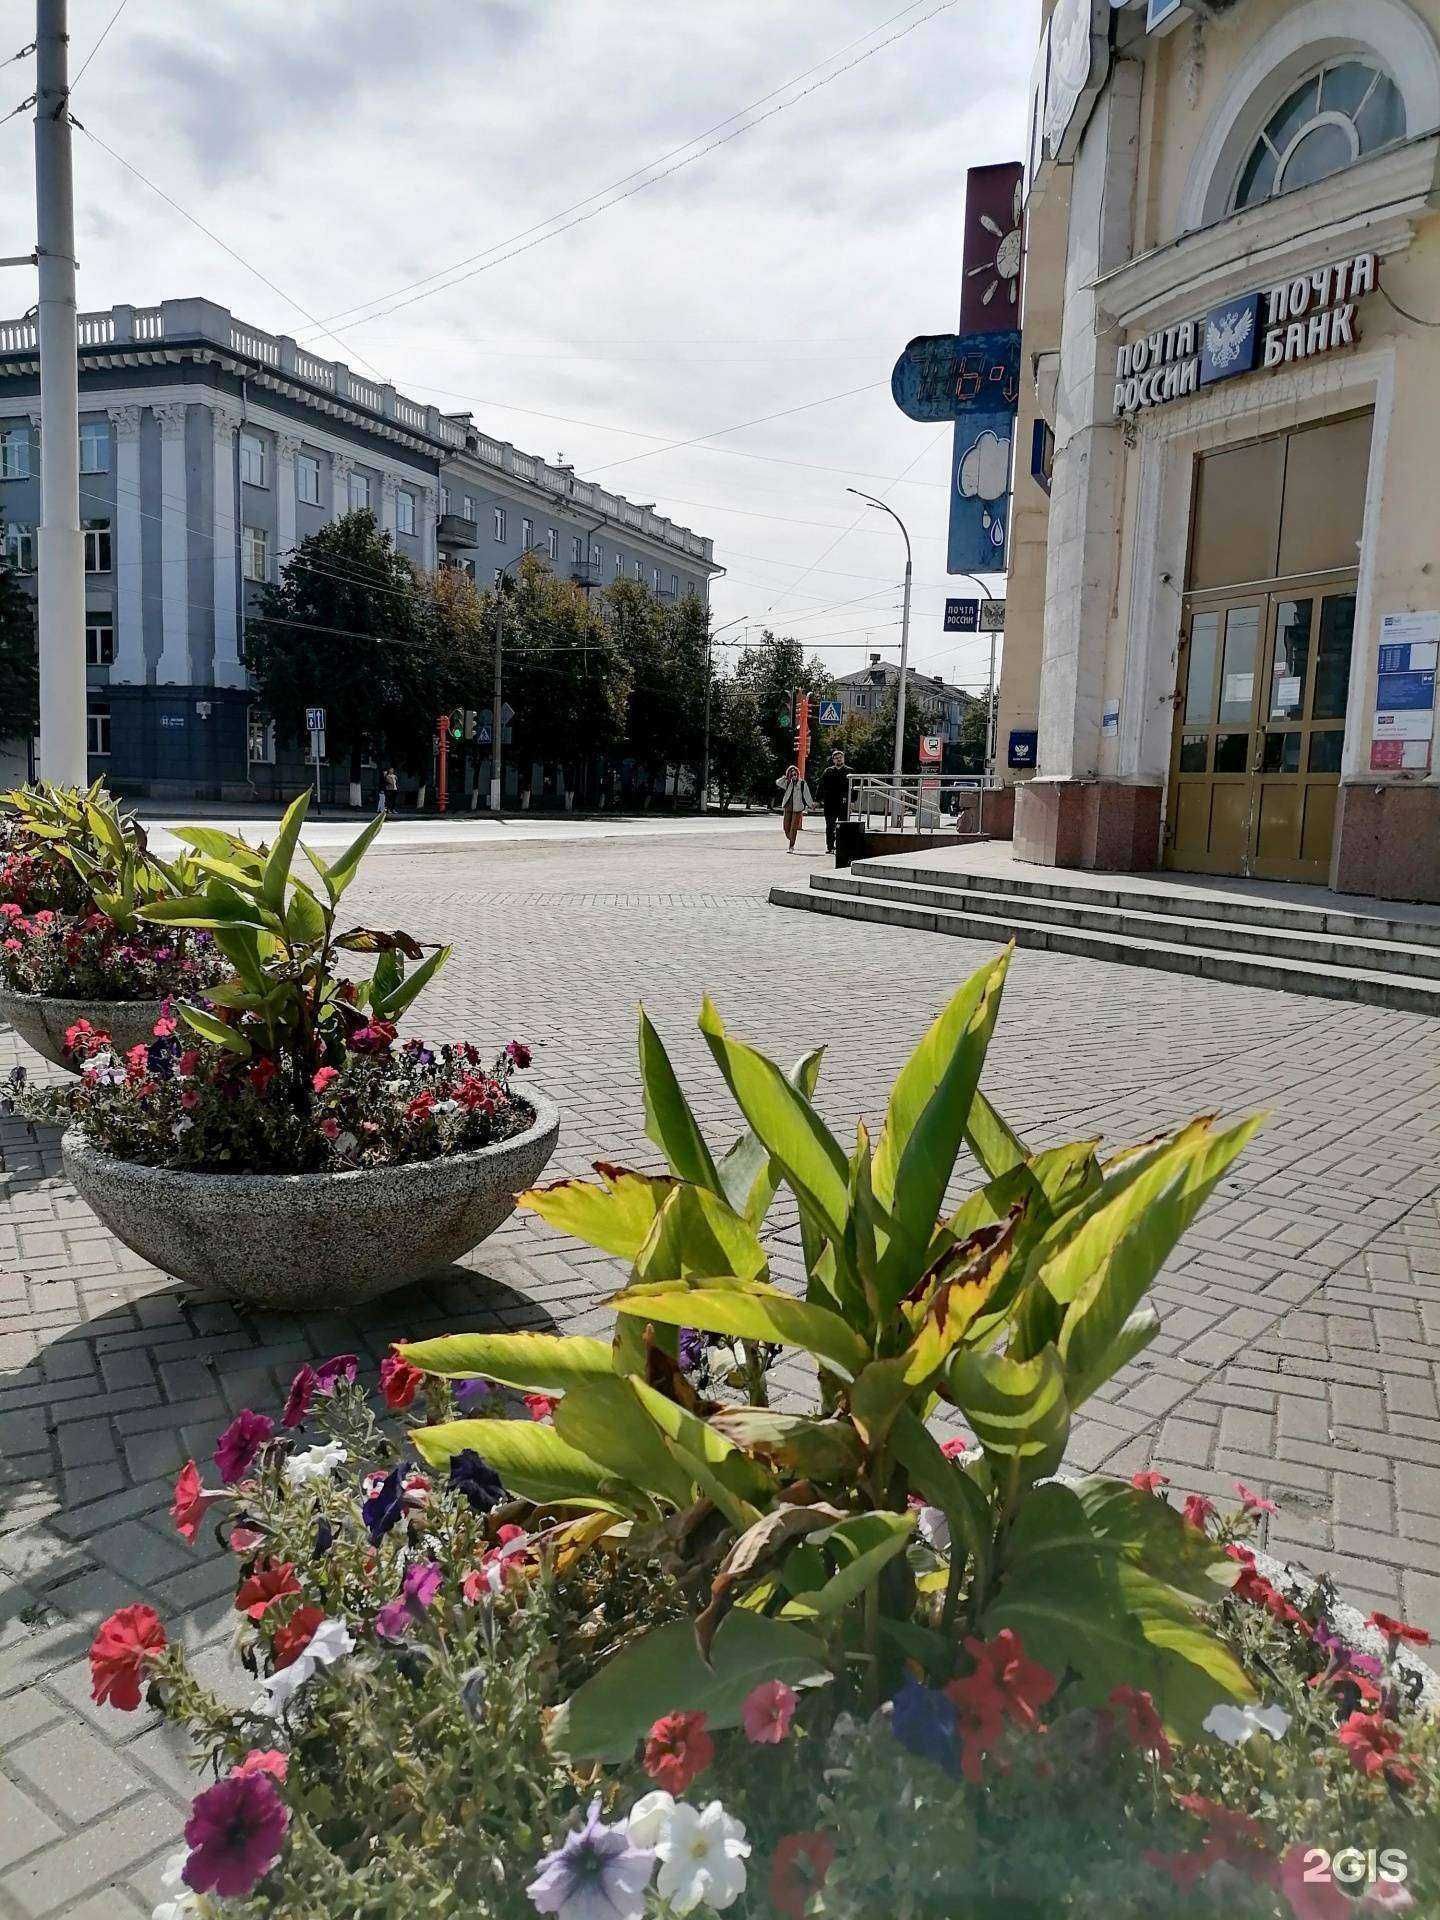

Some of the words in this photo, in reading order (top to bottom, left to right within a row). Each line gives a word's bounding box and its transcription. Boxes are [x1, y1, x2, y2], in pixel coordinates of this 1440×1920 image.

[1268, 253, 1378, 325] ПОЧТА
[1115, 320, 1197, 379] ПОЧТА
[1264, 303, 1356, 368] БАНК
[1113, 358, 1199, 417] РОССИИ
[947, 616, 974, 625] РОССИИ
[948, 606, 974, 615] ПОЧТА
